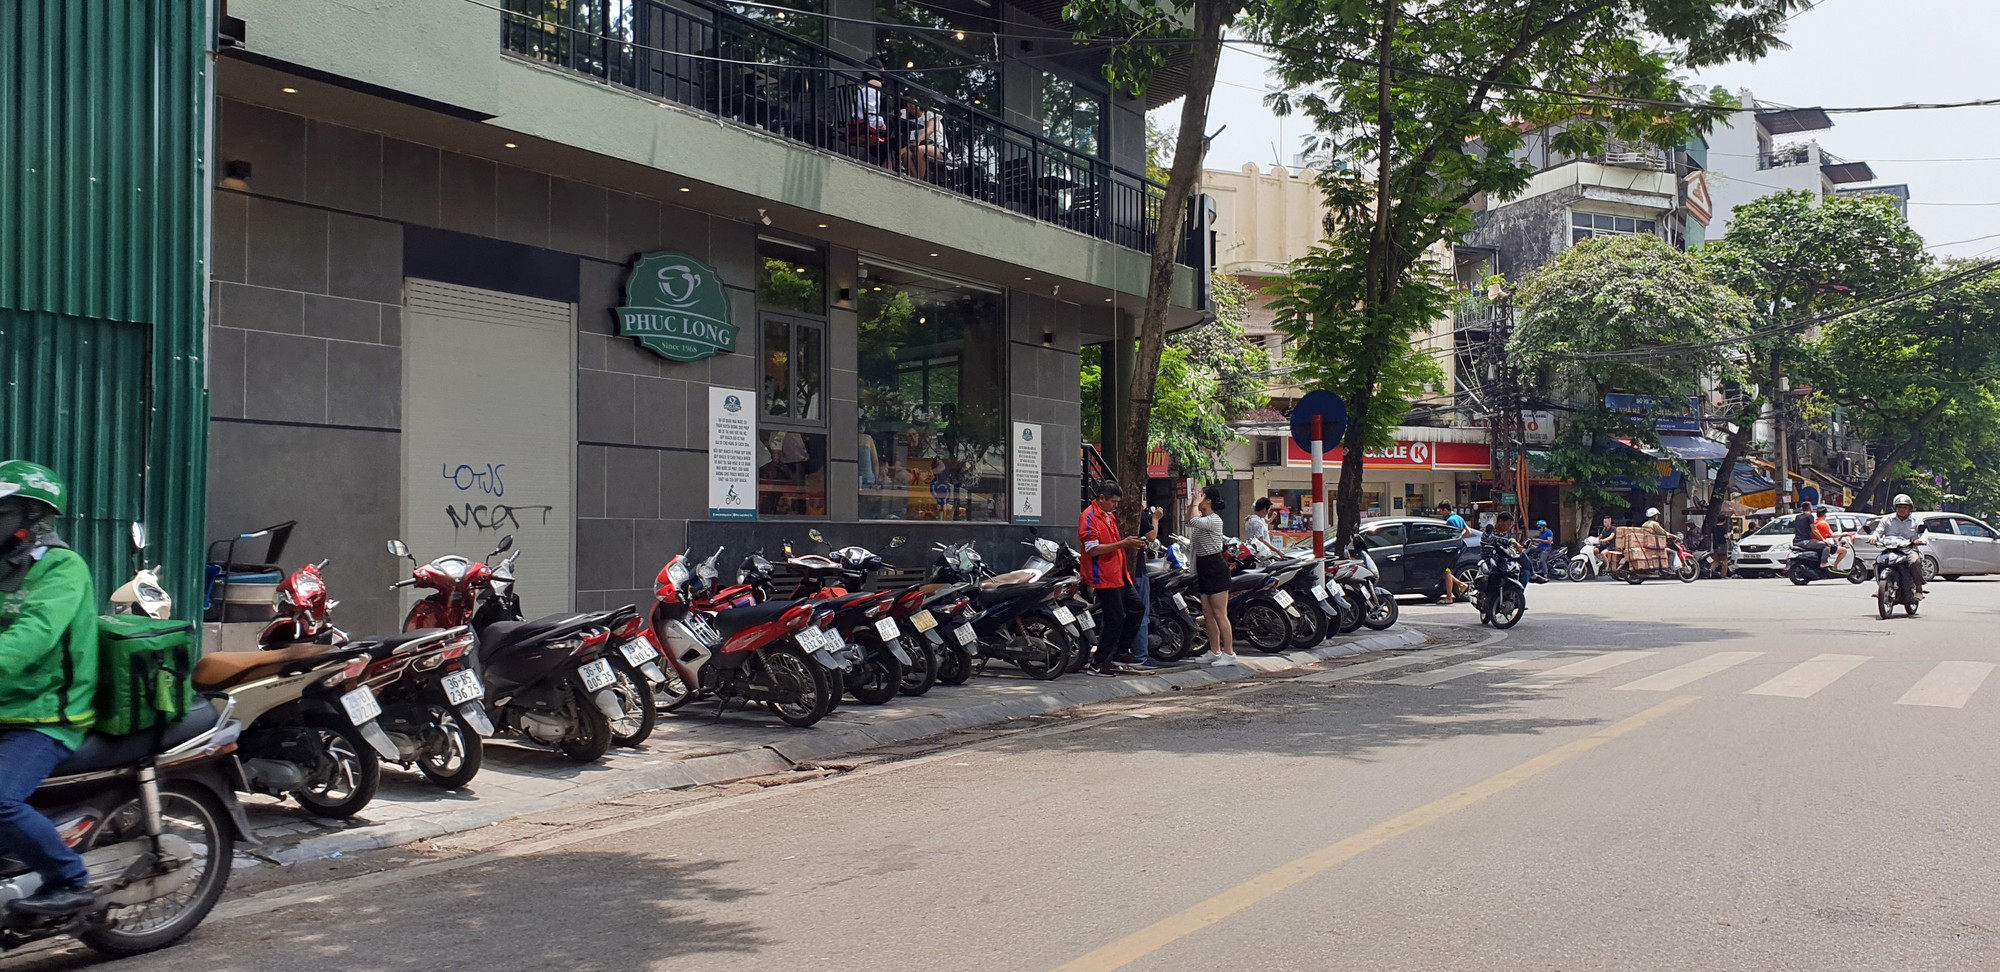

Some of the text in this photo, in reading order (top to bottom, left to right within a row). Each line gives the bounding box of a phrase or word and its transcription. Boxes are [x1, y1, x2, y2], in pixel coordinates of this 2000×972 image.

[624, 314, 730, 345] PHUC LONG
[661, 341, 698, 353] Since 1968
[587, 672, 614, 690] 005.35
[450, 684, 481, 703] 236.75
